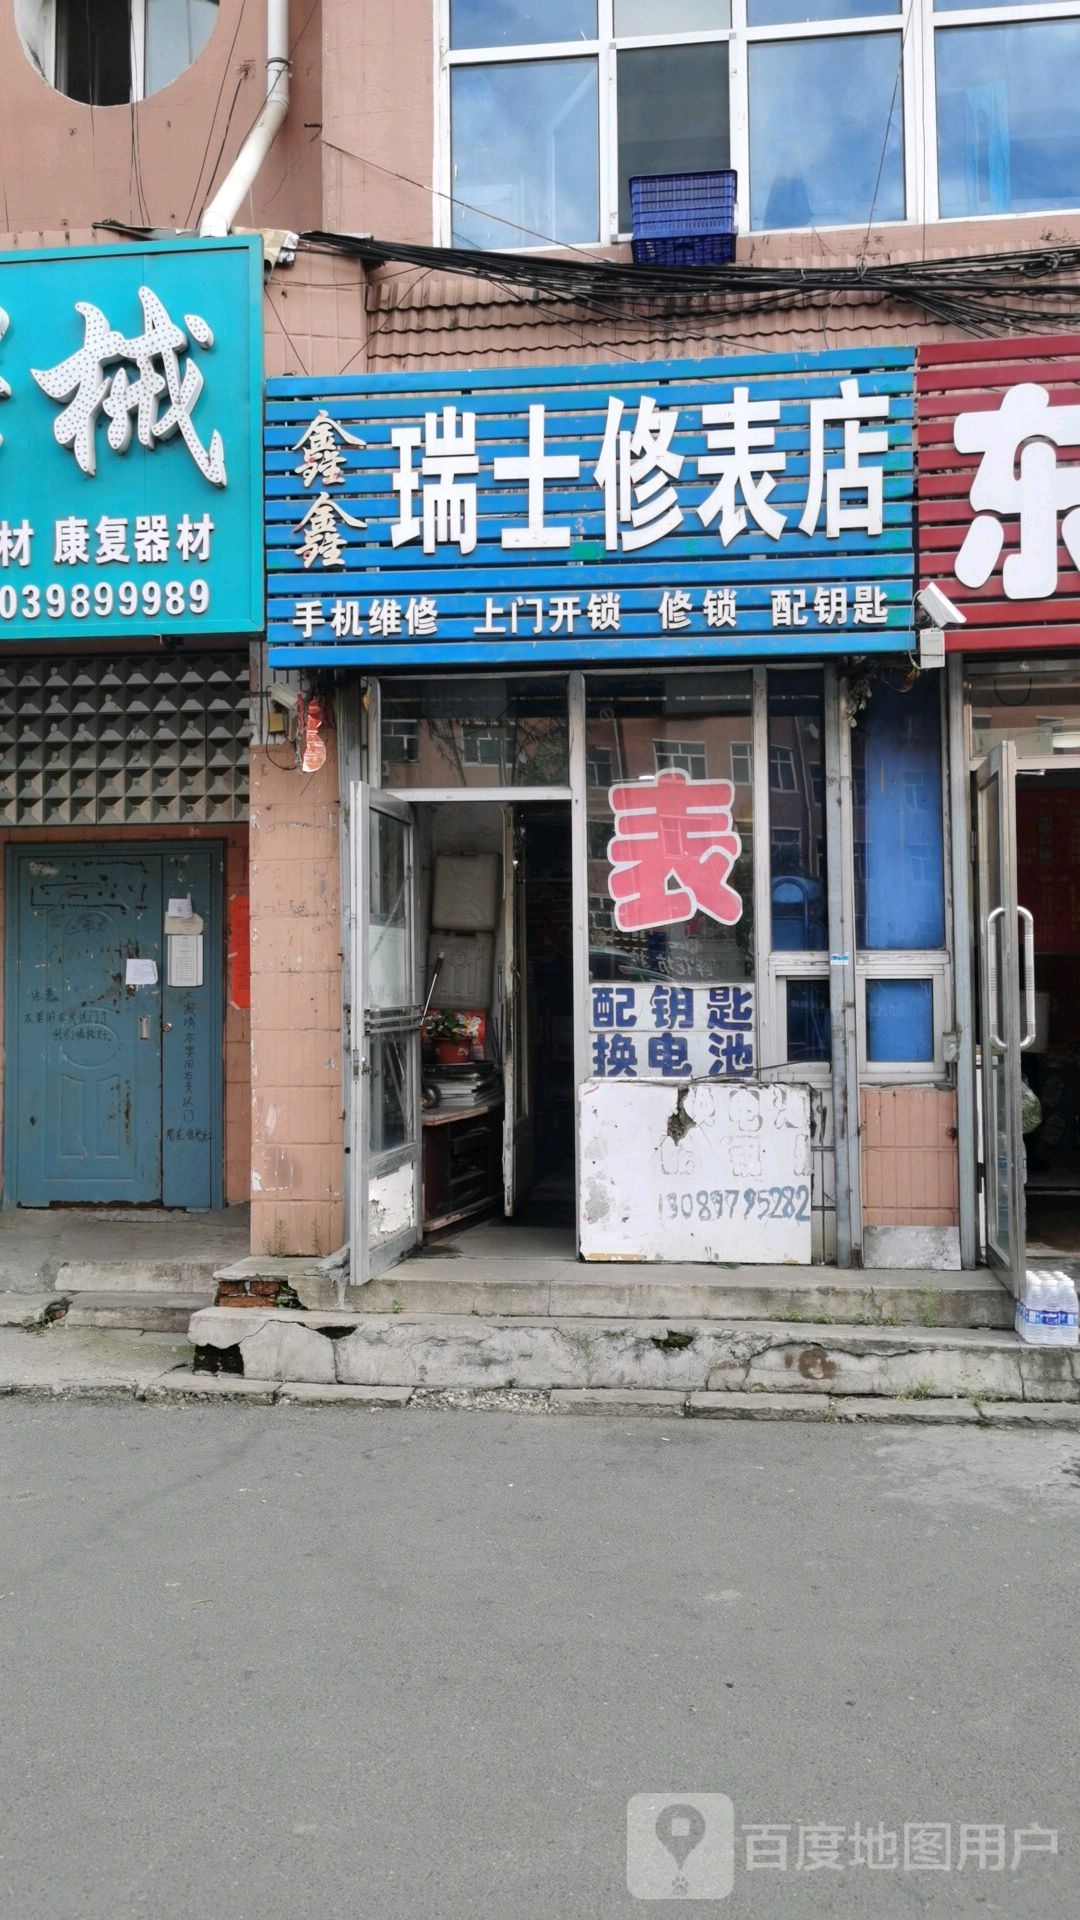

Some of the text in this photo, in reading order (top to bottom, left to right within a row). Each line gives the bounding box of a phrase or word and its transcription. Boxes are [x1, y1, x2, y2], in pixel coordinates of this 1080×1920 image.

[0, 285, 228, 489] 械
[292, 409, 367, 570] 鑫鑫
[390, 378, 890, 555] 瑞士修表店
[953, 382, 1080, 602] 东
[54, 514, 215, 567] 康复器材
[292, 598, 439, 640] 手机维修
[473, 591, 621, 635] 上门开锁
[659, 588, 738, 630] 修锁
[771, 586, 889, 627] 配钥匙
[607, 768, 744, 932] 表
[593, 986, 753, 1032] 配钥匙
[593, 1033, 753, 1078] 换电池
